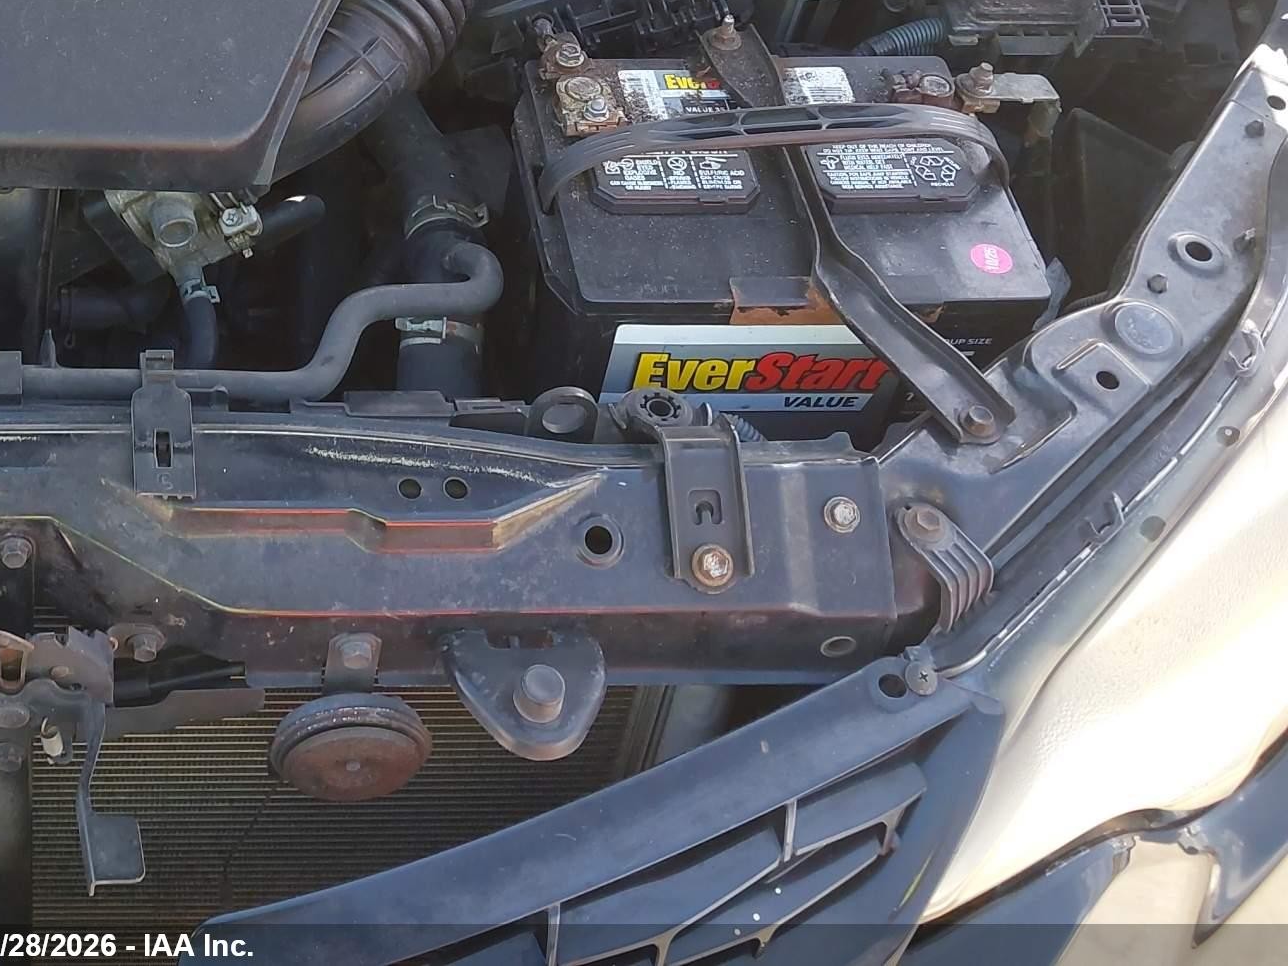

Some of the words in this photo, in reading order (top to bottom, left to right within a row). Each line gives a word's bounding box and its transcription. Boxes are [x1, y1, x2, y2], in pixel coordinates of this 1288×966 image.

[966, 337, 992, 345] SIZE
[631, 350, 891, 391] EverStart
[784, 396, 860, 408] VALUE
